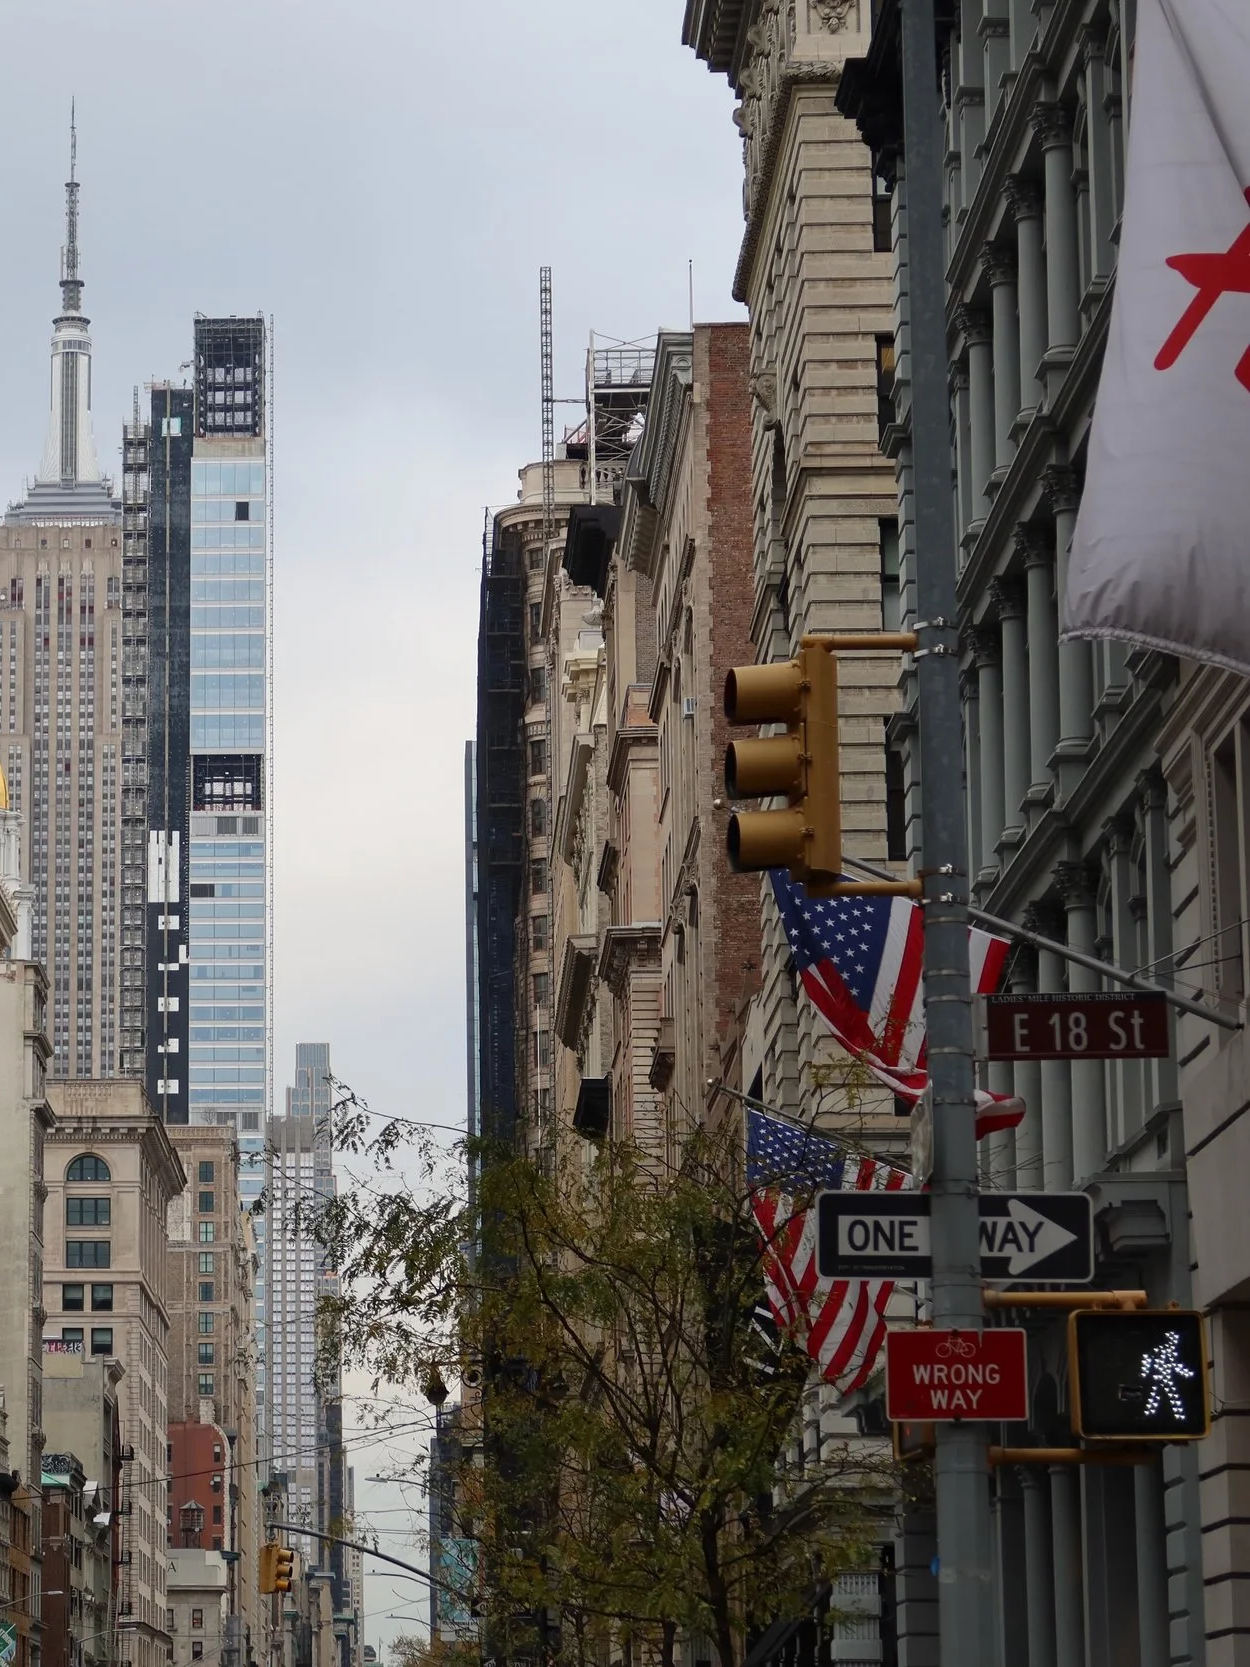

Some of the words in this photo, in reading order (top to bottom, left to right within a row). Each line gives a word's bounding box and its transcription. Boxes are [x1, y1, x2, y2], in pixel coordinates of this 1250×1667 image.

[1028, 994, 1051, 1003] MILE
[1052, 993, 1093, 1002] HISTORIC
[1095, 992, 1136, 1001] DISTRICT
[1013, 1012, 1031, 1052] E
[1048, 1011, 1089, 1052] 18
[1108, 1009, 1146, 1051] St
[847, 1219, 919, 1252] ONE
[912, 1363, 1001, 1385] WRONG
[930, 1389, 983, 1410] WAY
